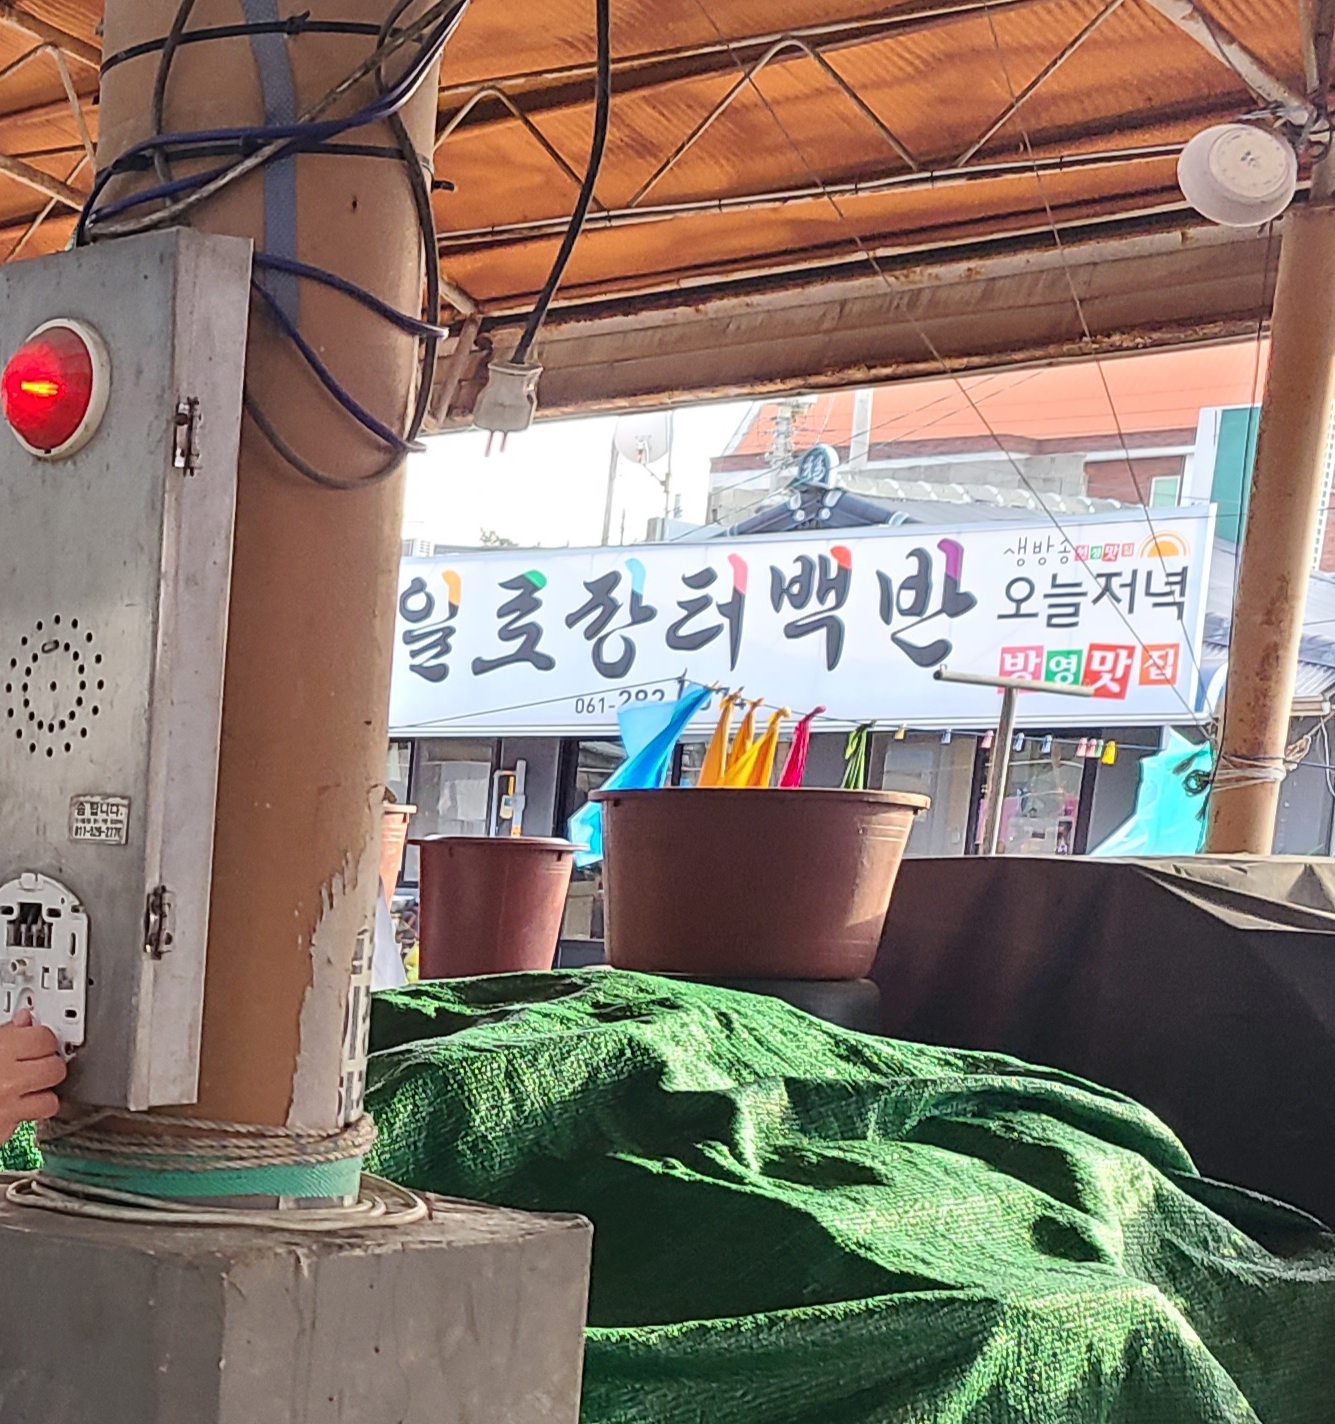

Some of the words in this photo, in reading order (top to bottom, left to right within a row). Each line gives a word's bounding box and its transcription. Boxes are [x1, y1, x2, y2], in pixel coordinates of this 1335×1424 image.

[1003, 536, 1072, 567] 생방송
[398, 538, 979, 684] 일로장터백반
[996, 565, 1189, 629] 오늘저녁
[1000, 647, 1177, 695] 방영맛집
